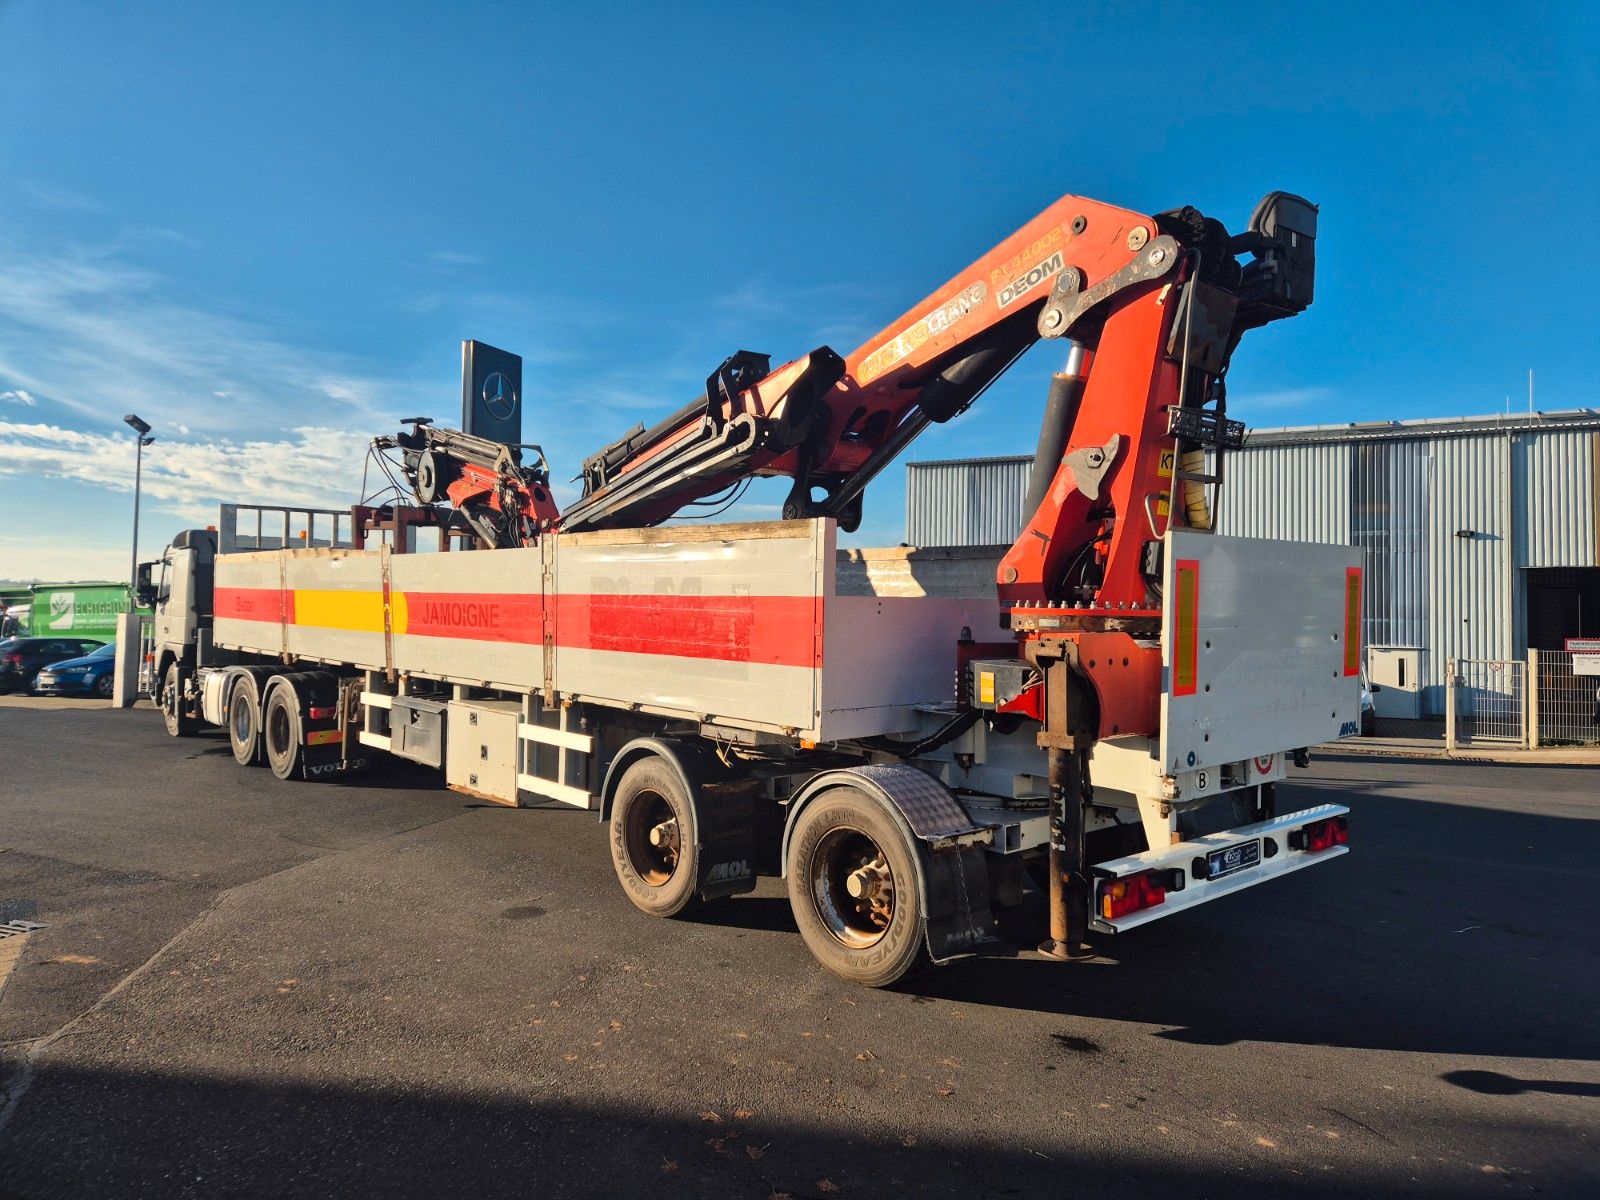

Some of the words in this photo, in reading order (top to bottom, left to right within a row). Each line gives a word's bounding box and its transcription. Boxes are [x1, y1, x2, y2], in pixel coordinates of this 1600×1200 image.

[1000, 253, 1062, 306] DEOM
[422, 601, 500, 628] JAMOIGNE
[1338, 720, 1358, 737] MOL
[309, 758, 367, 775] VOO
[1198, 772, 1207, 789] B
[705, 859, 751, 882] MOL
[847, 871, 907, 969] GOODYEAR
